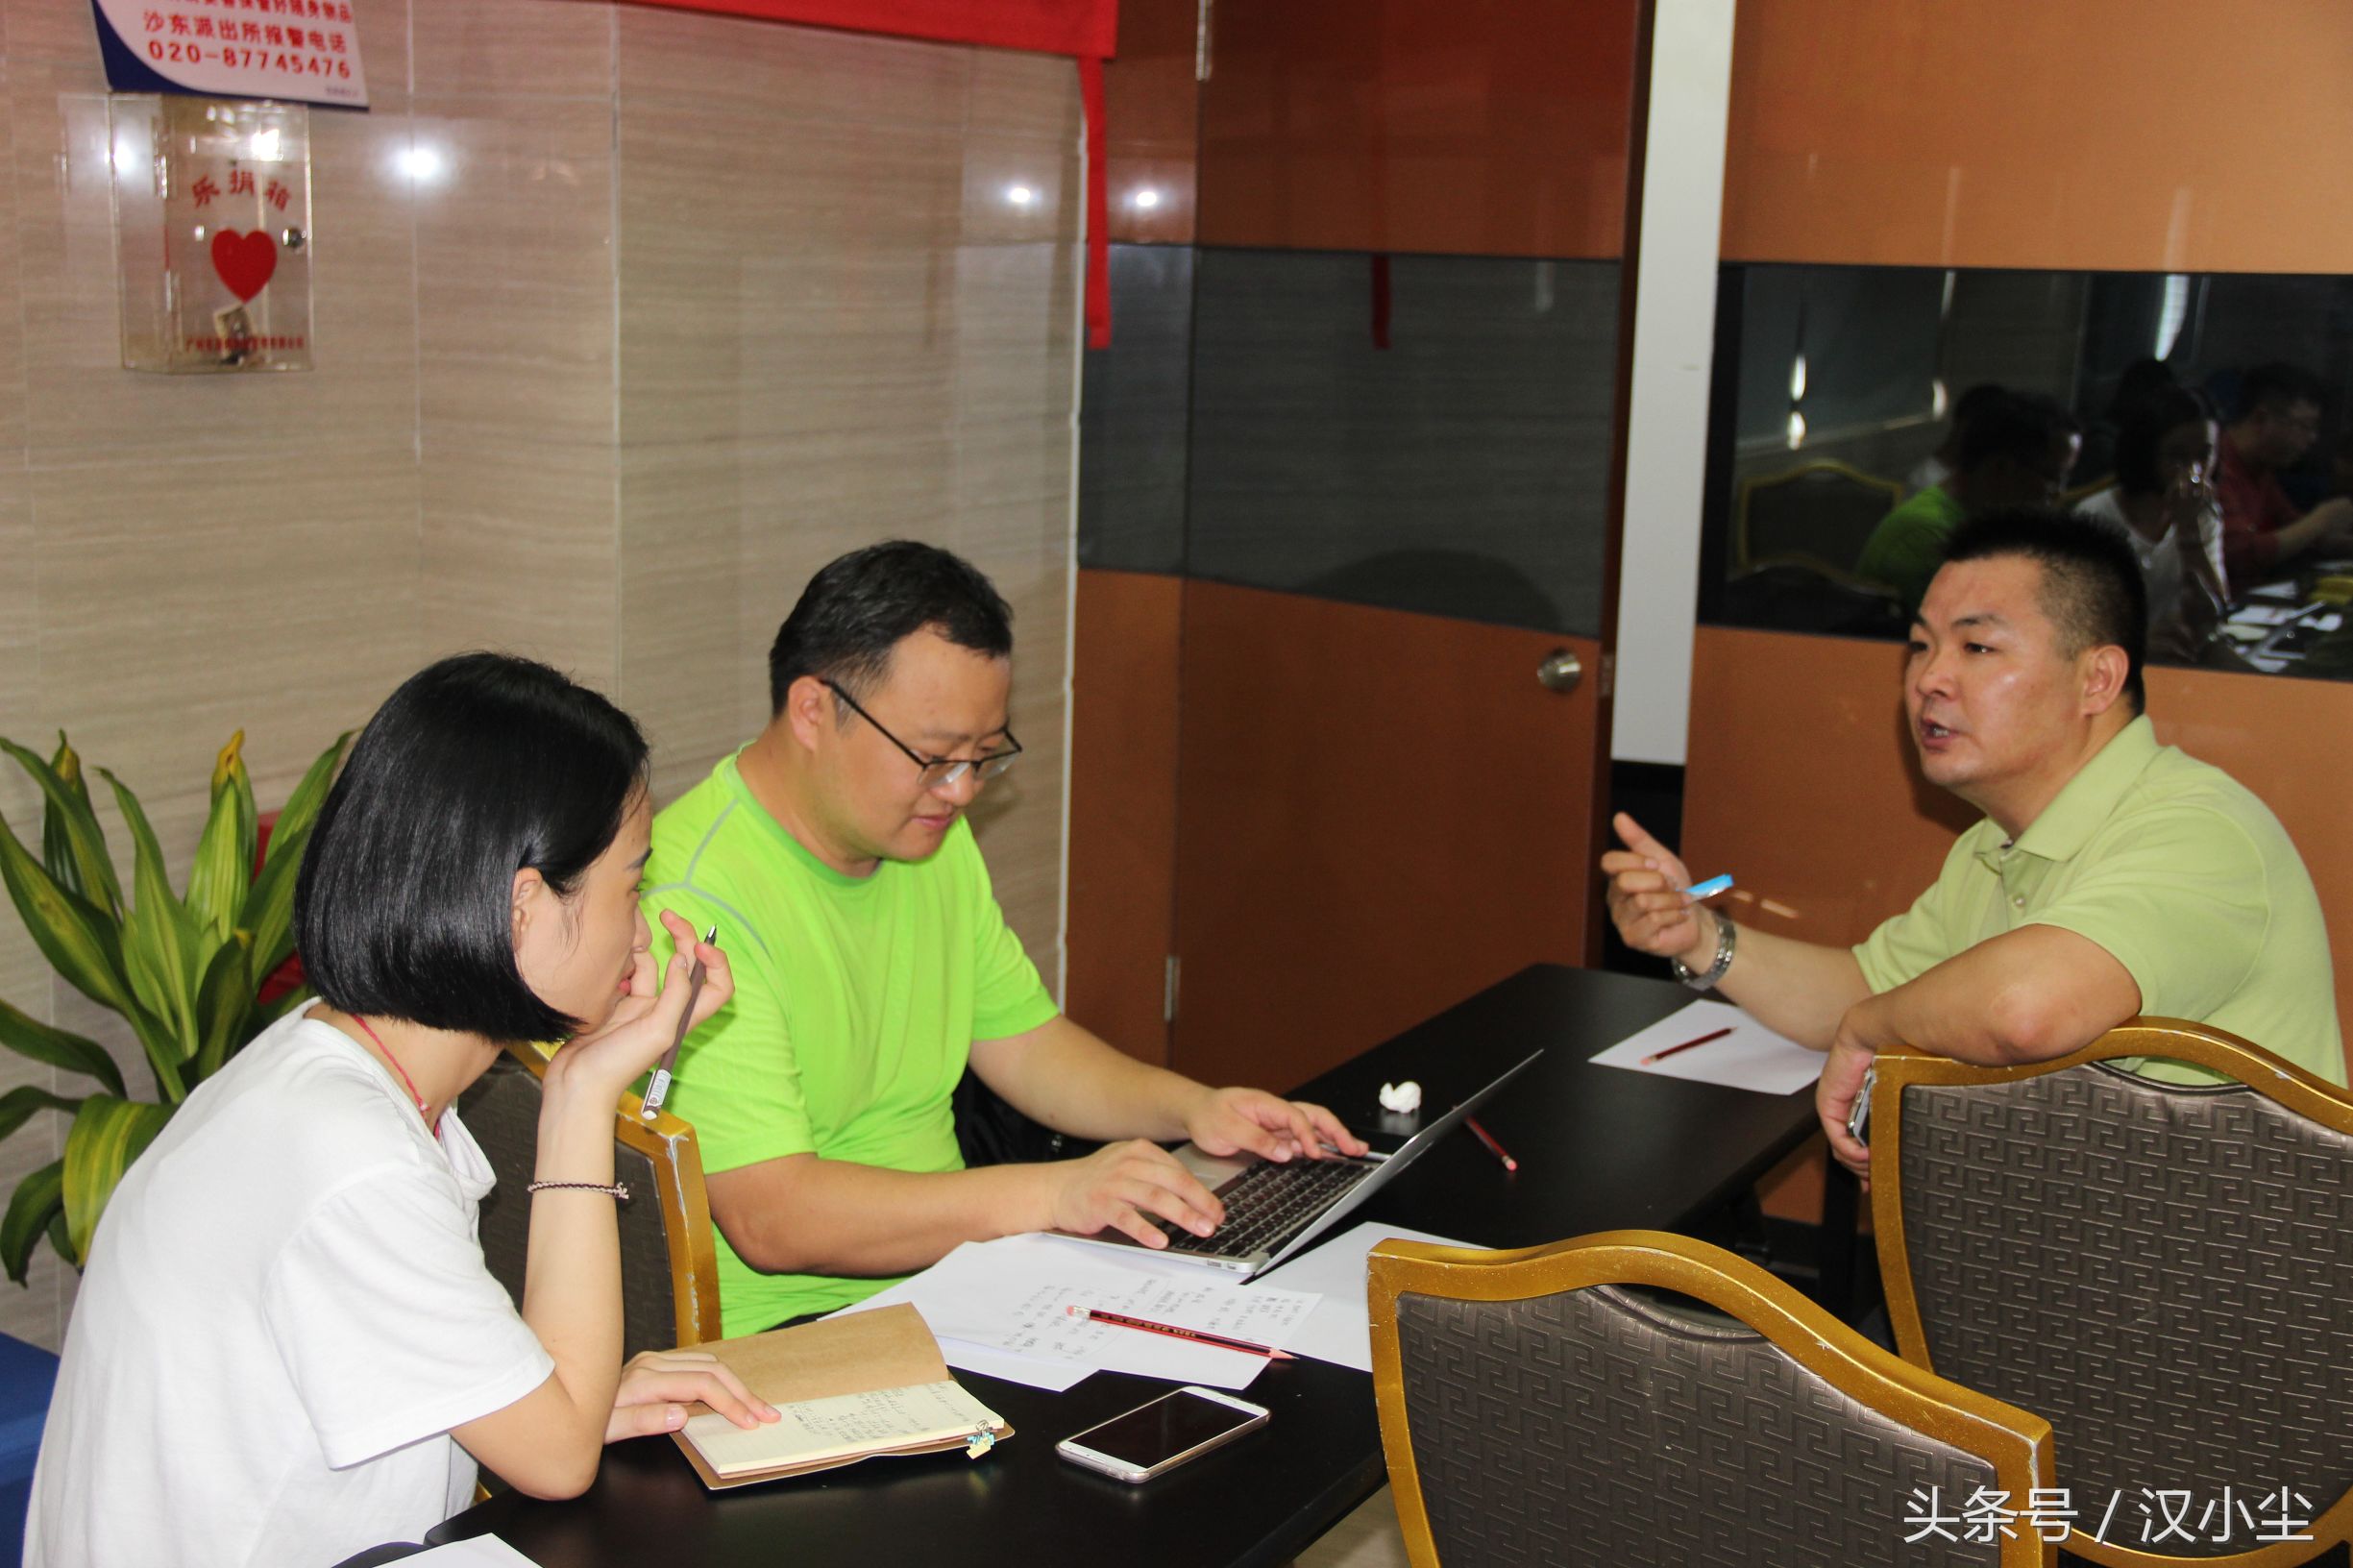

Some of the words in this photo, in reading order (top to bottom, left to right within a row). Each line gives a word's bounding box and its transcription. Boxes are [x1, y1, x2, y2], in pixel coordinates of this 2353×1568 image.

[144, 9, 346, 53] 沙东派出所报警电话
[149, 39, 351, 79] 020-87745476
